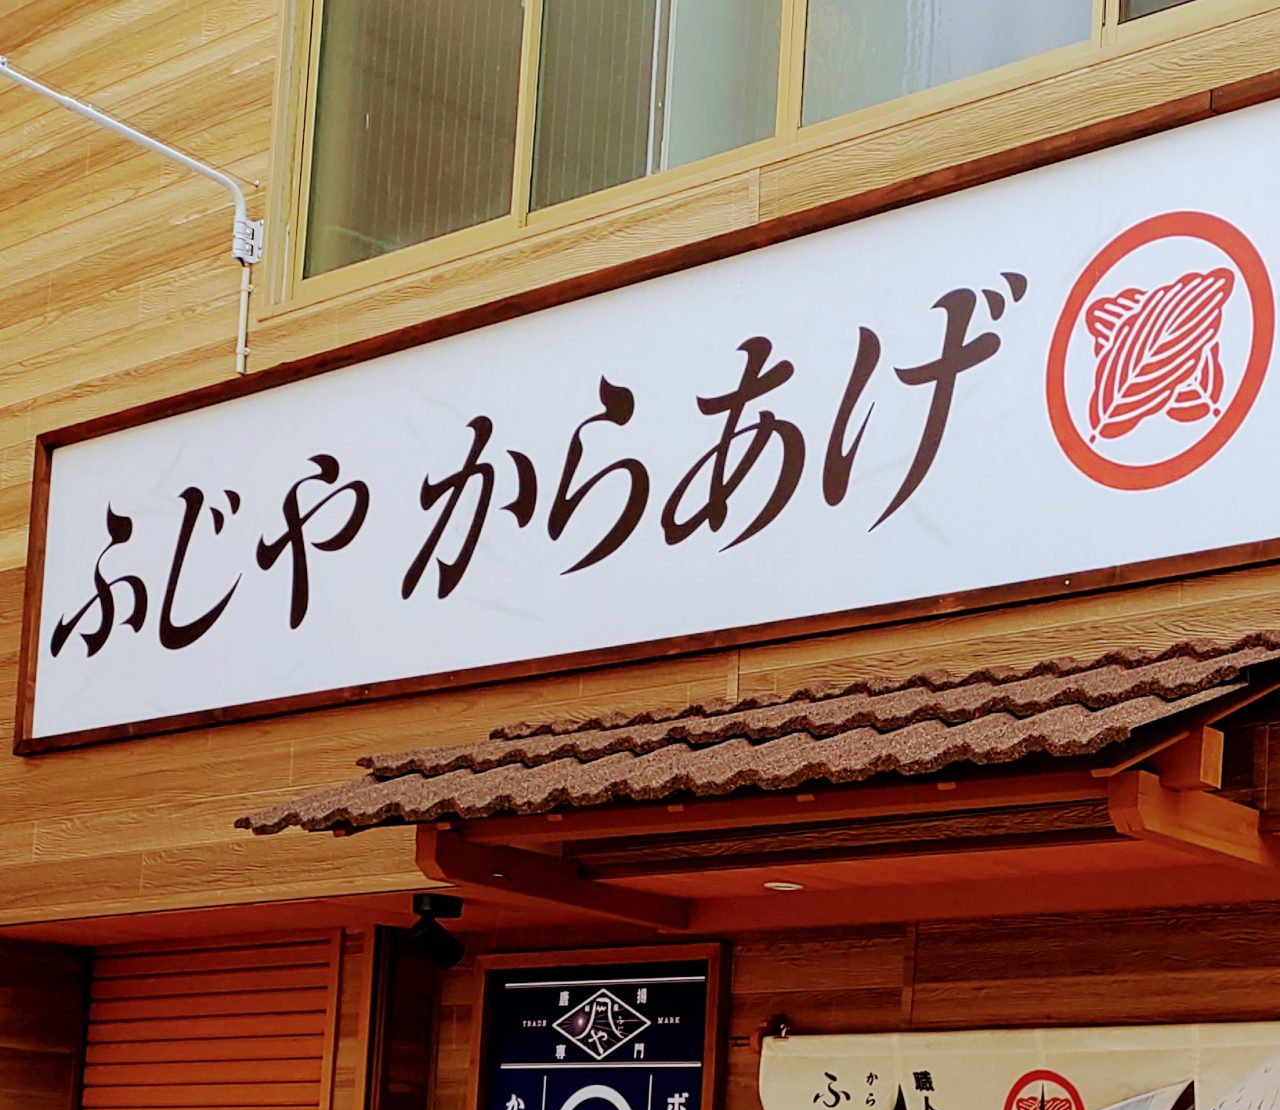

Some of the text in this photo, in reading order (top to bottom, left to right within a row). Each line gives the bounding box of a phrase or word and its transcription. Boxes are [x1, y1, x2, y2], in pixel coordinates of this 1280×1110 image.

[51, 453, 370, 659] ふじや
[401, 271, 1027, 600] からあげ
